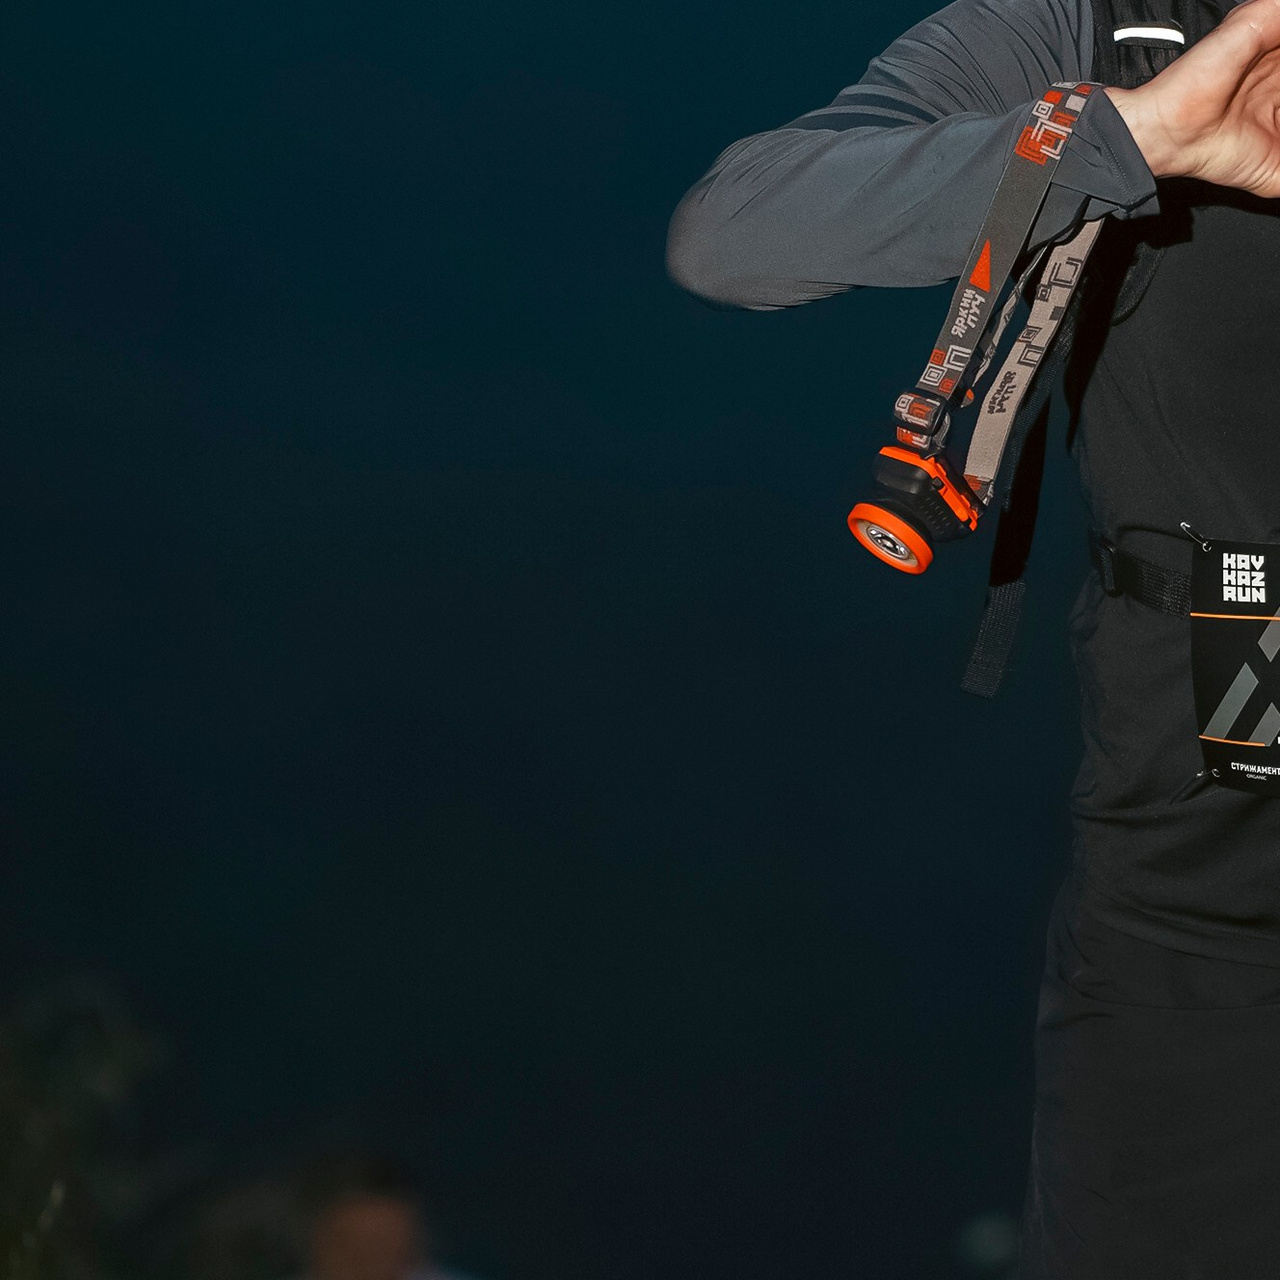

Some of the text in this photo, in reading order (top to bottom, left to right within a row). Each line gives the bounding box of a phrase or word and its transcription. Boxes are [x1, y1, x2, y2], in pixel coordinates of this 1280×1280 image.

[1222, 552, 1265, 570] KAV
[1222, 569, 1266, 587] KAZ
[1222, 586, 1266, 604] RUN
[1230, 762, 1280, 776] СТРИЖАМЕНТ
